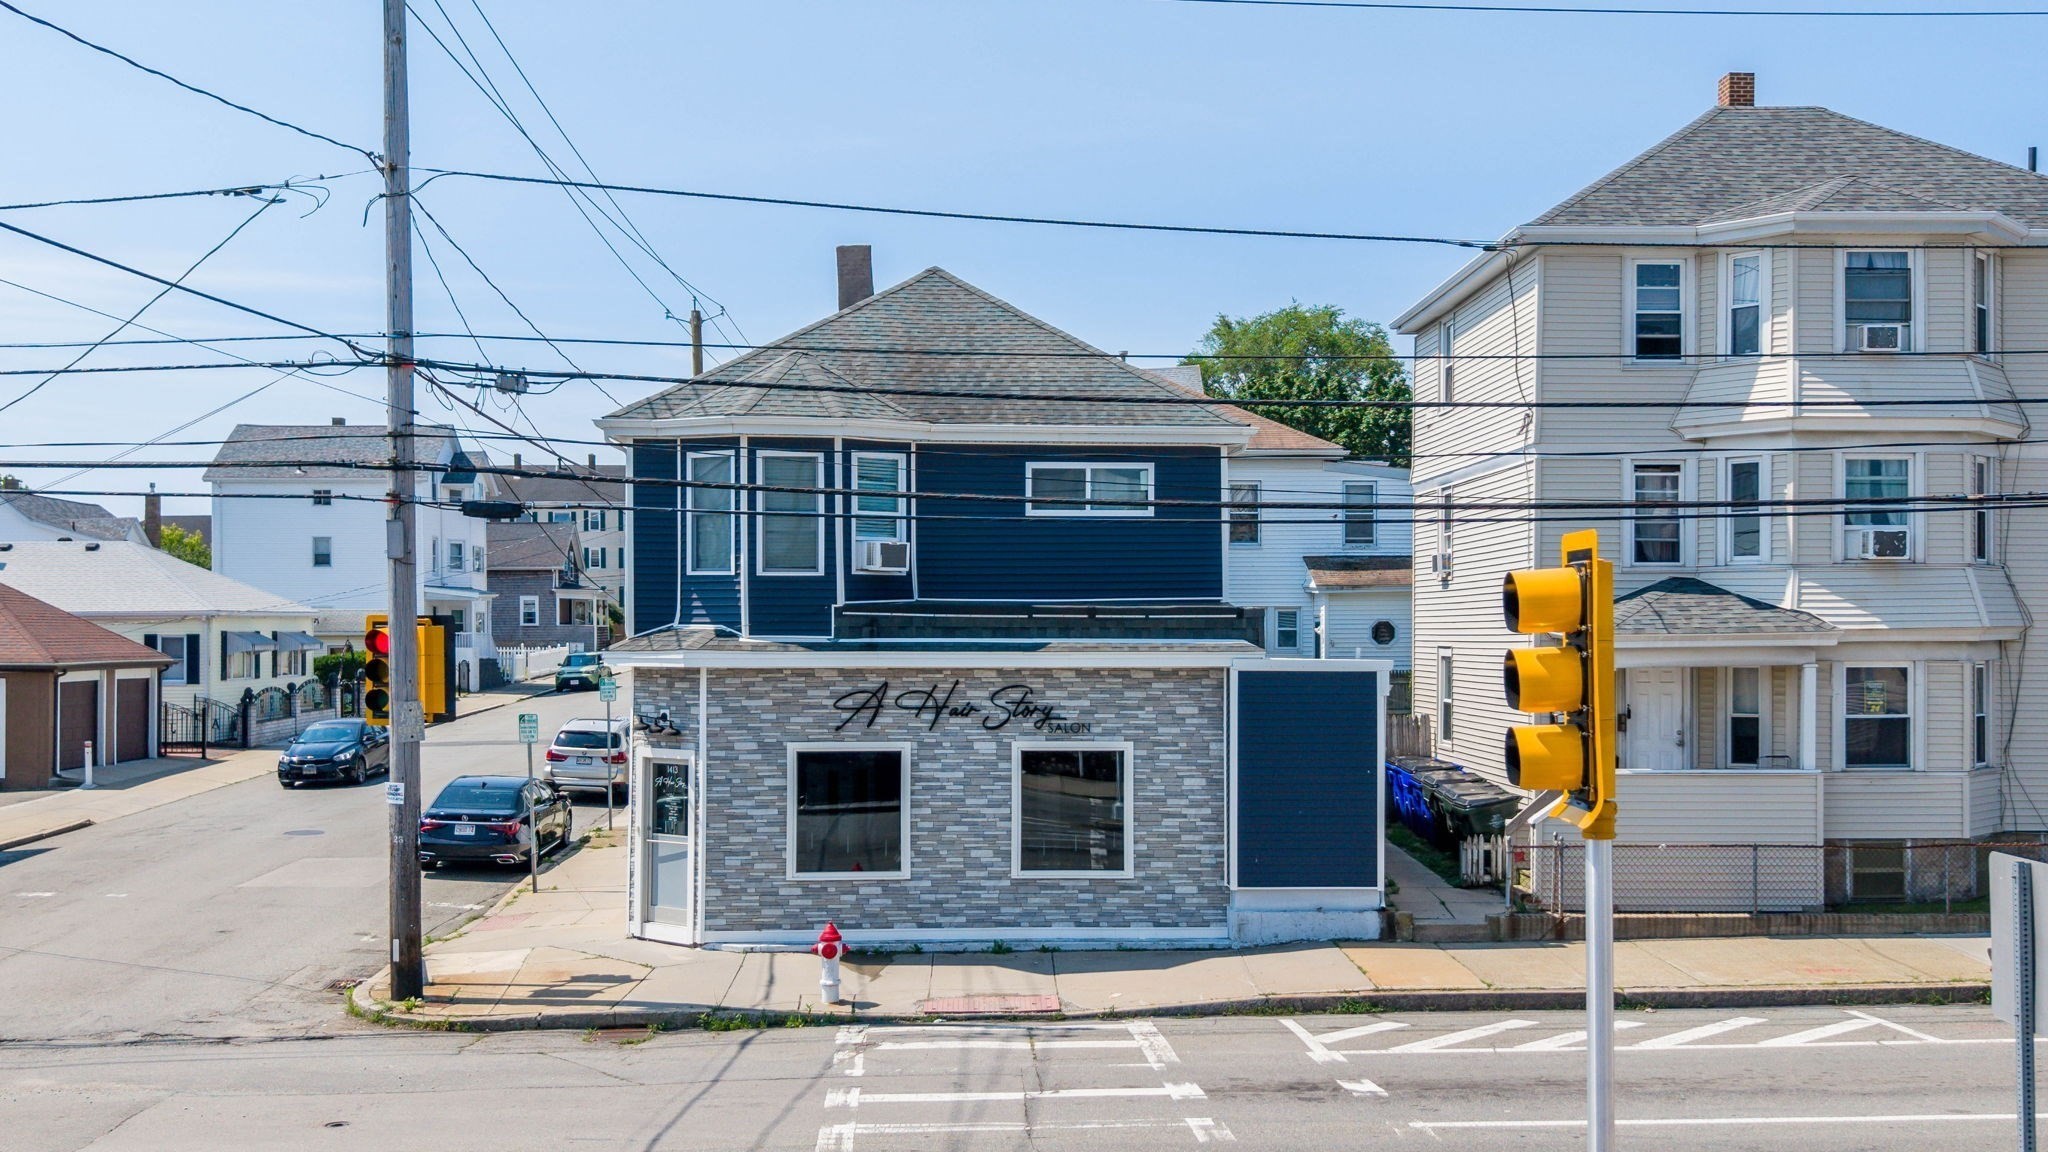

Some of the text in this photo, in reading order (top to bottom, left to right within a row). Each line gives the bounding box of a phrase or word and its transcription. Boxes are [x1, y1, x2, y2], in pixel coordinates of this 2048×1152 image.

[833, 679, 1067, 731] A Hair Story
[1047, 722, 1091, 734] SALON
[667, 765, 678, 774] 1413
